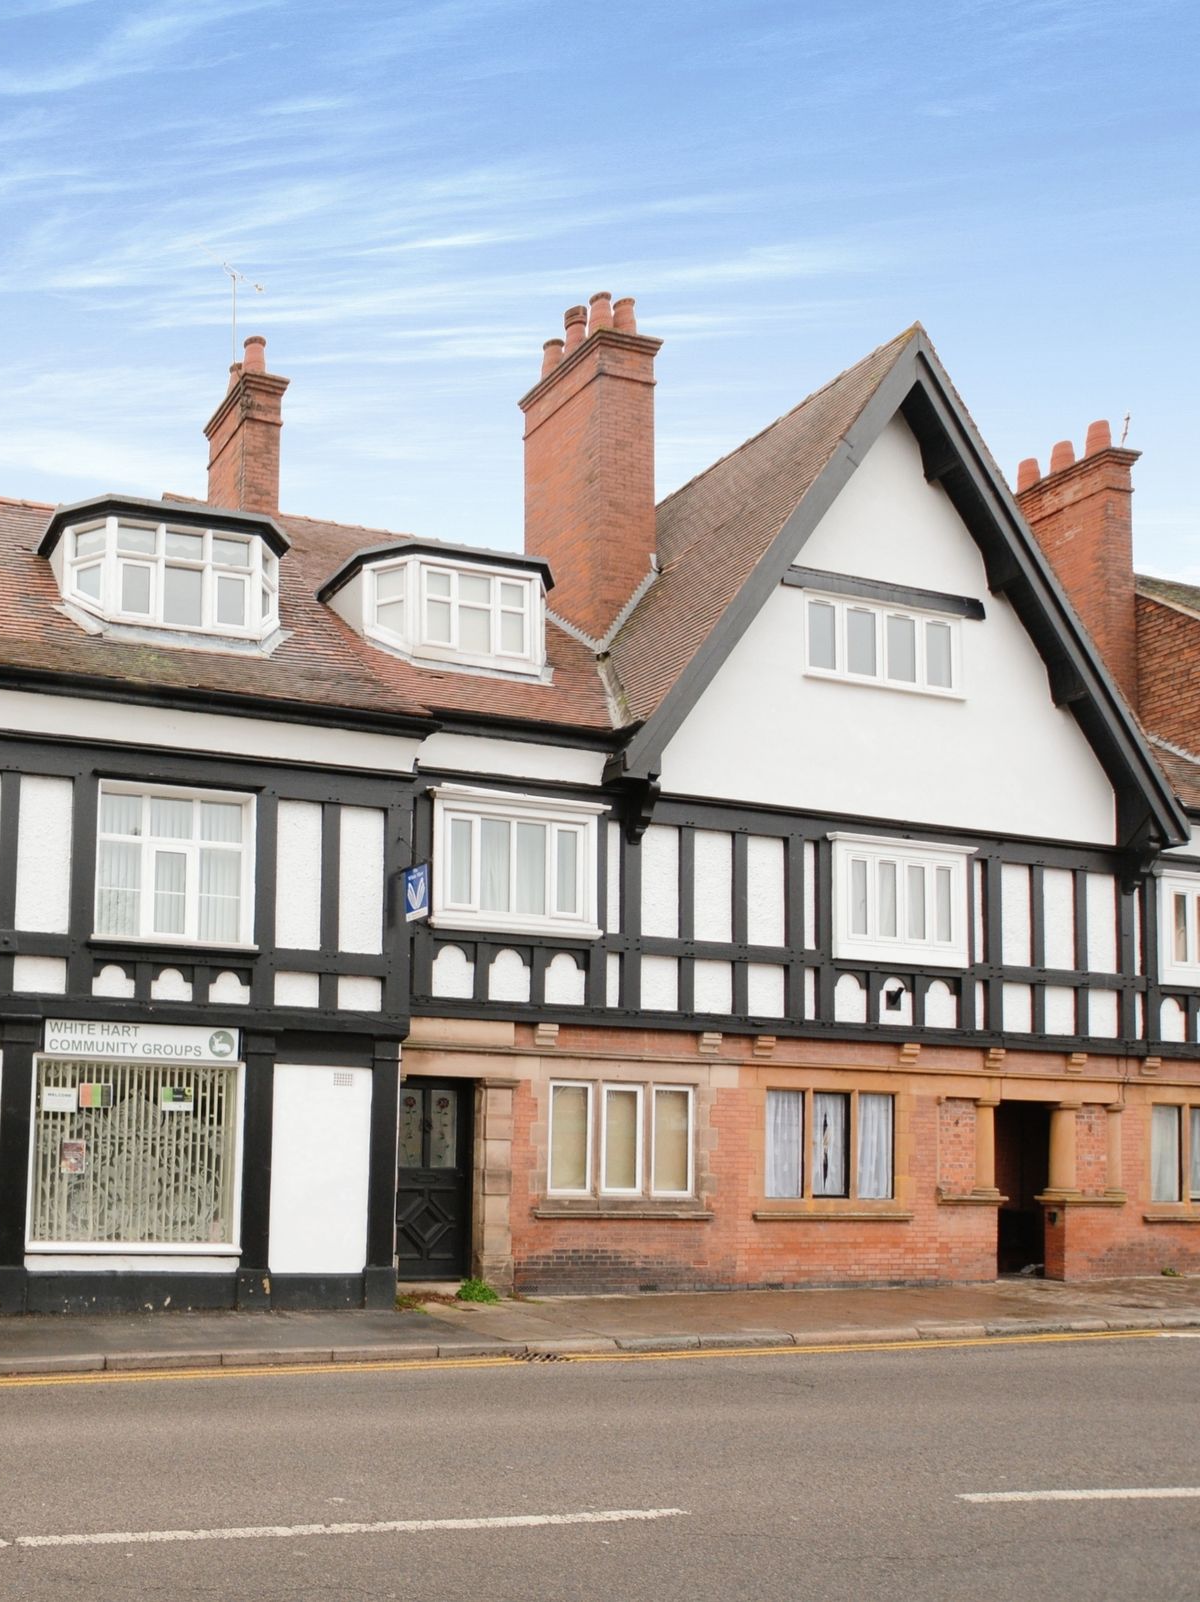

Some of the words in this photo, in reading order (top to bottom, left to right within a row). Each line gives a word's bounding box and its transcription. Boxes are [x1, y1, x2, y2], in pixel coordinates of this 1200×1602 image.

[50, 1021, 97, 1036] WHITE
[100, 1024, 141, 1037] HART
[49, 1038, 139, 1054] COMMUNITY
[142, 1043, 202, 1057] GROUPS
